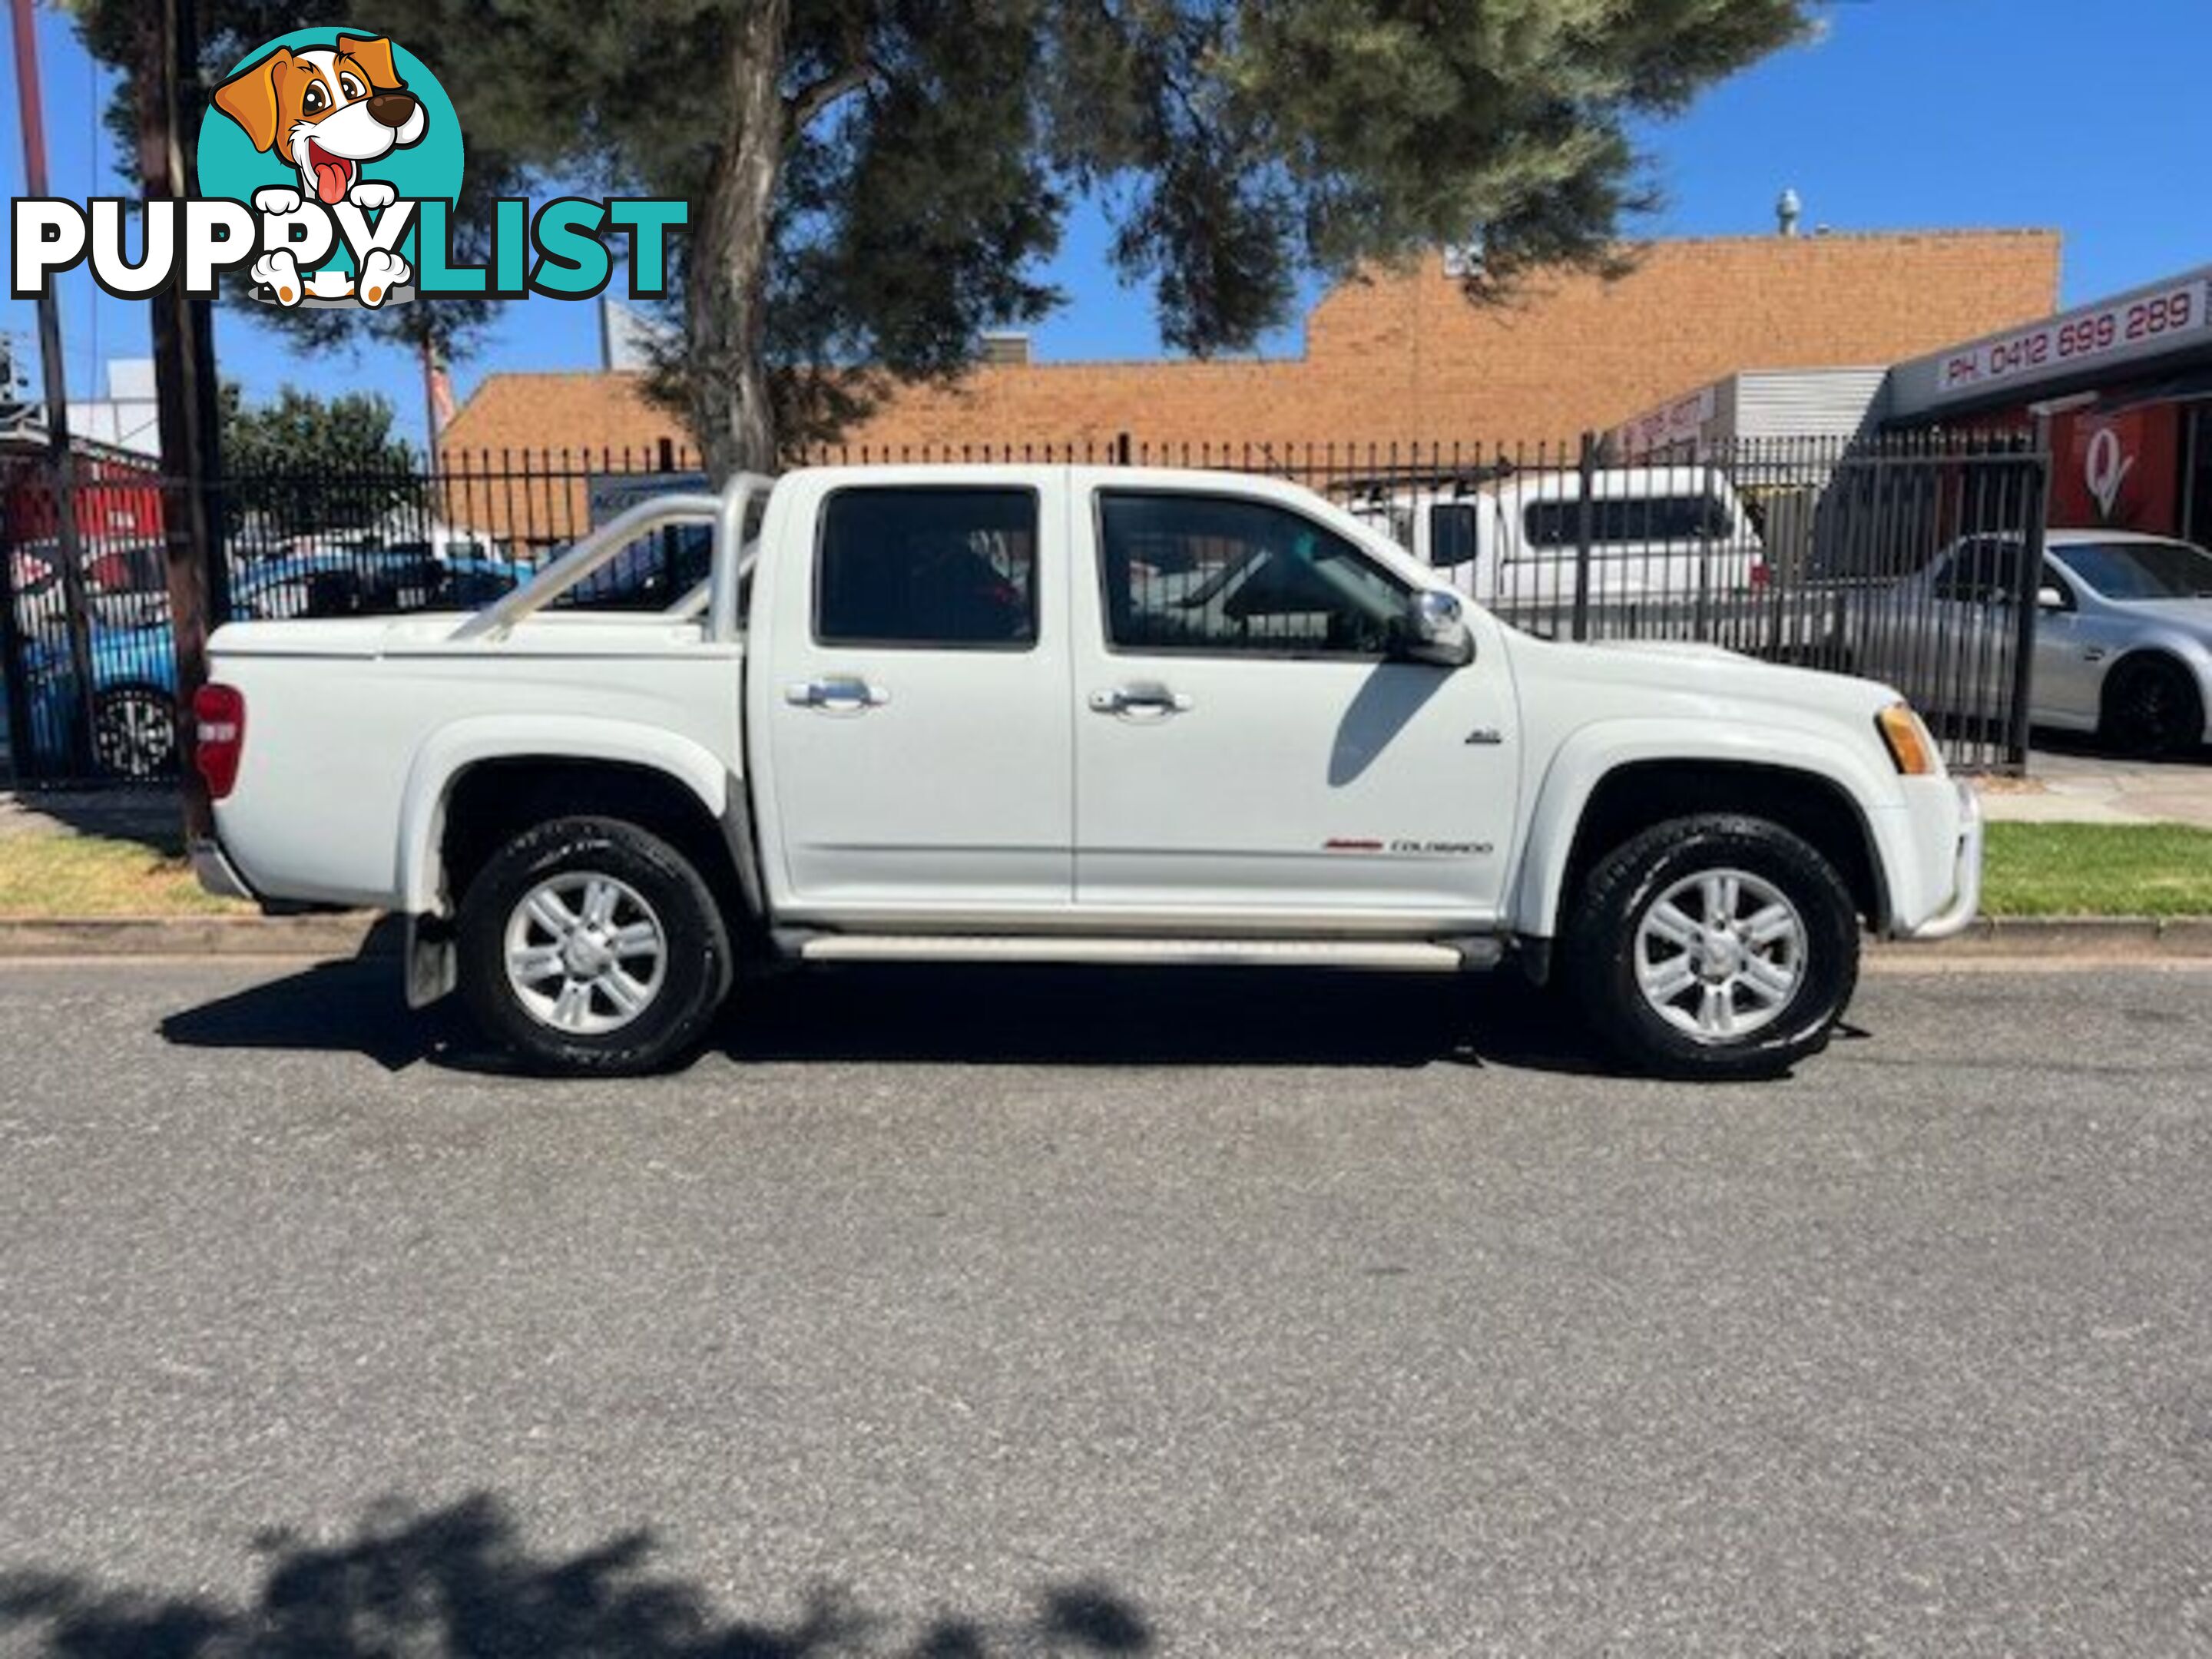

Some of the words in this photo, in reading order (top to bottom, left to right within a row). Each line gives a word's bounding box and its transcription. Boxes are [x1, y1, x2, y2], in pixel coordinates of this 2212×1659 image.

[1990, 333, 2048, 375] 0412
[2058, 313, 2116, 357] 699
[2125, 293, 2191, 339] 289
